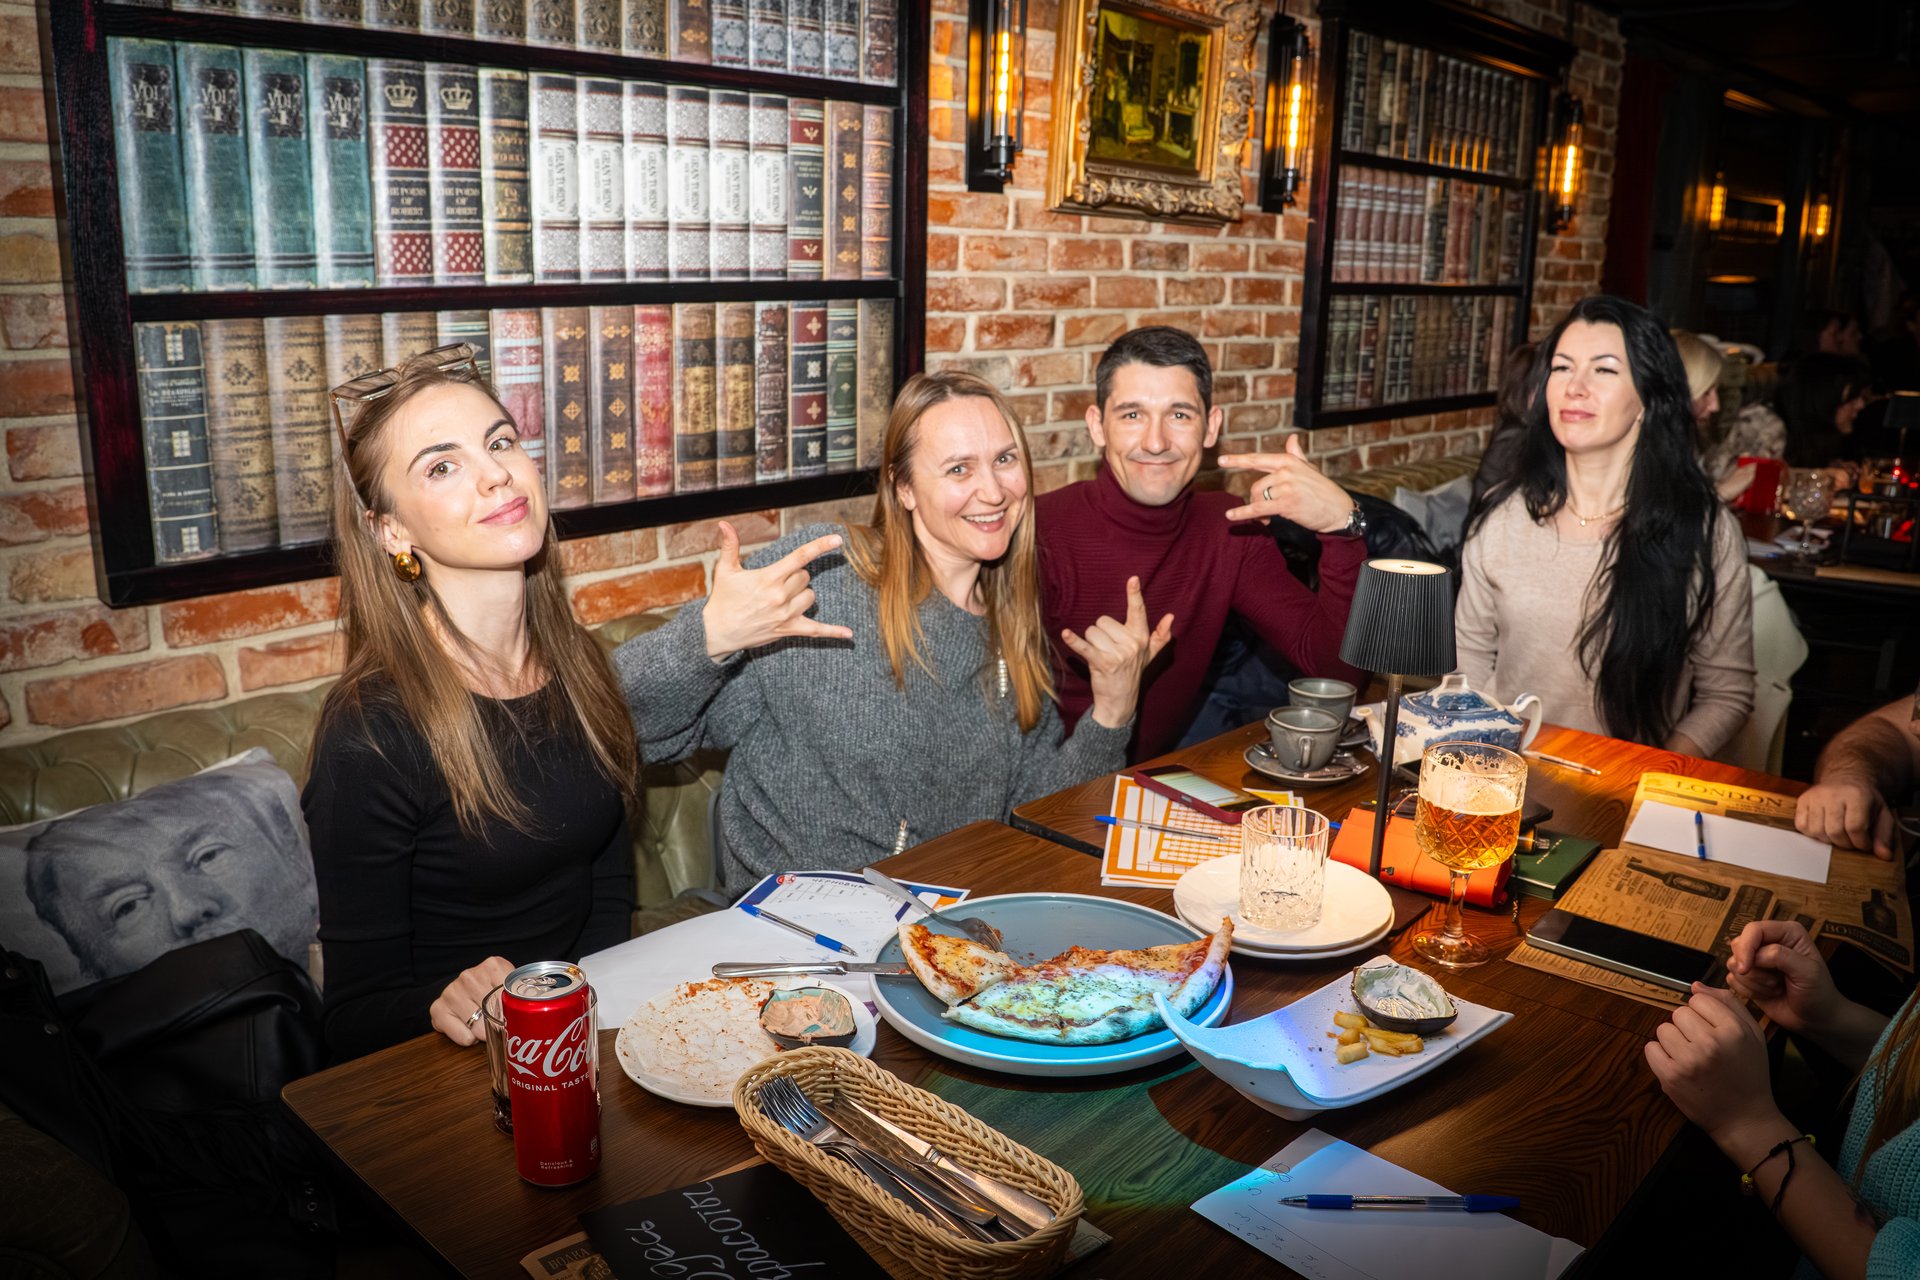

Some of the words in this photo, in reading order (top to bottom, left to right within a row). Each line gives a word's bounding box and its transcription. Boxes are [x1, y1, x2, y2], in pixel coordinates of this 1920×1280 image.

[1676, 780, 1782, 808] LONDON
[812, 877, 865, 890] ЧЕРНОВИК
[511, 1077, 558, 1092] ORIGINAL
[561, 1071, 589, 1089] TASTE
